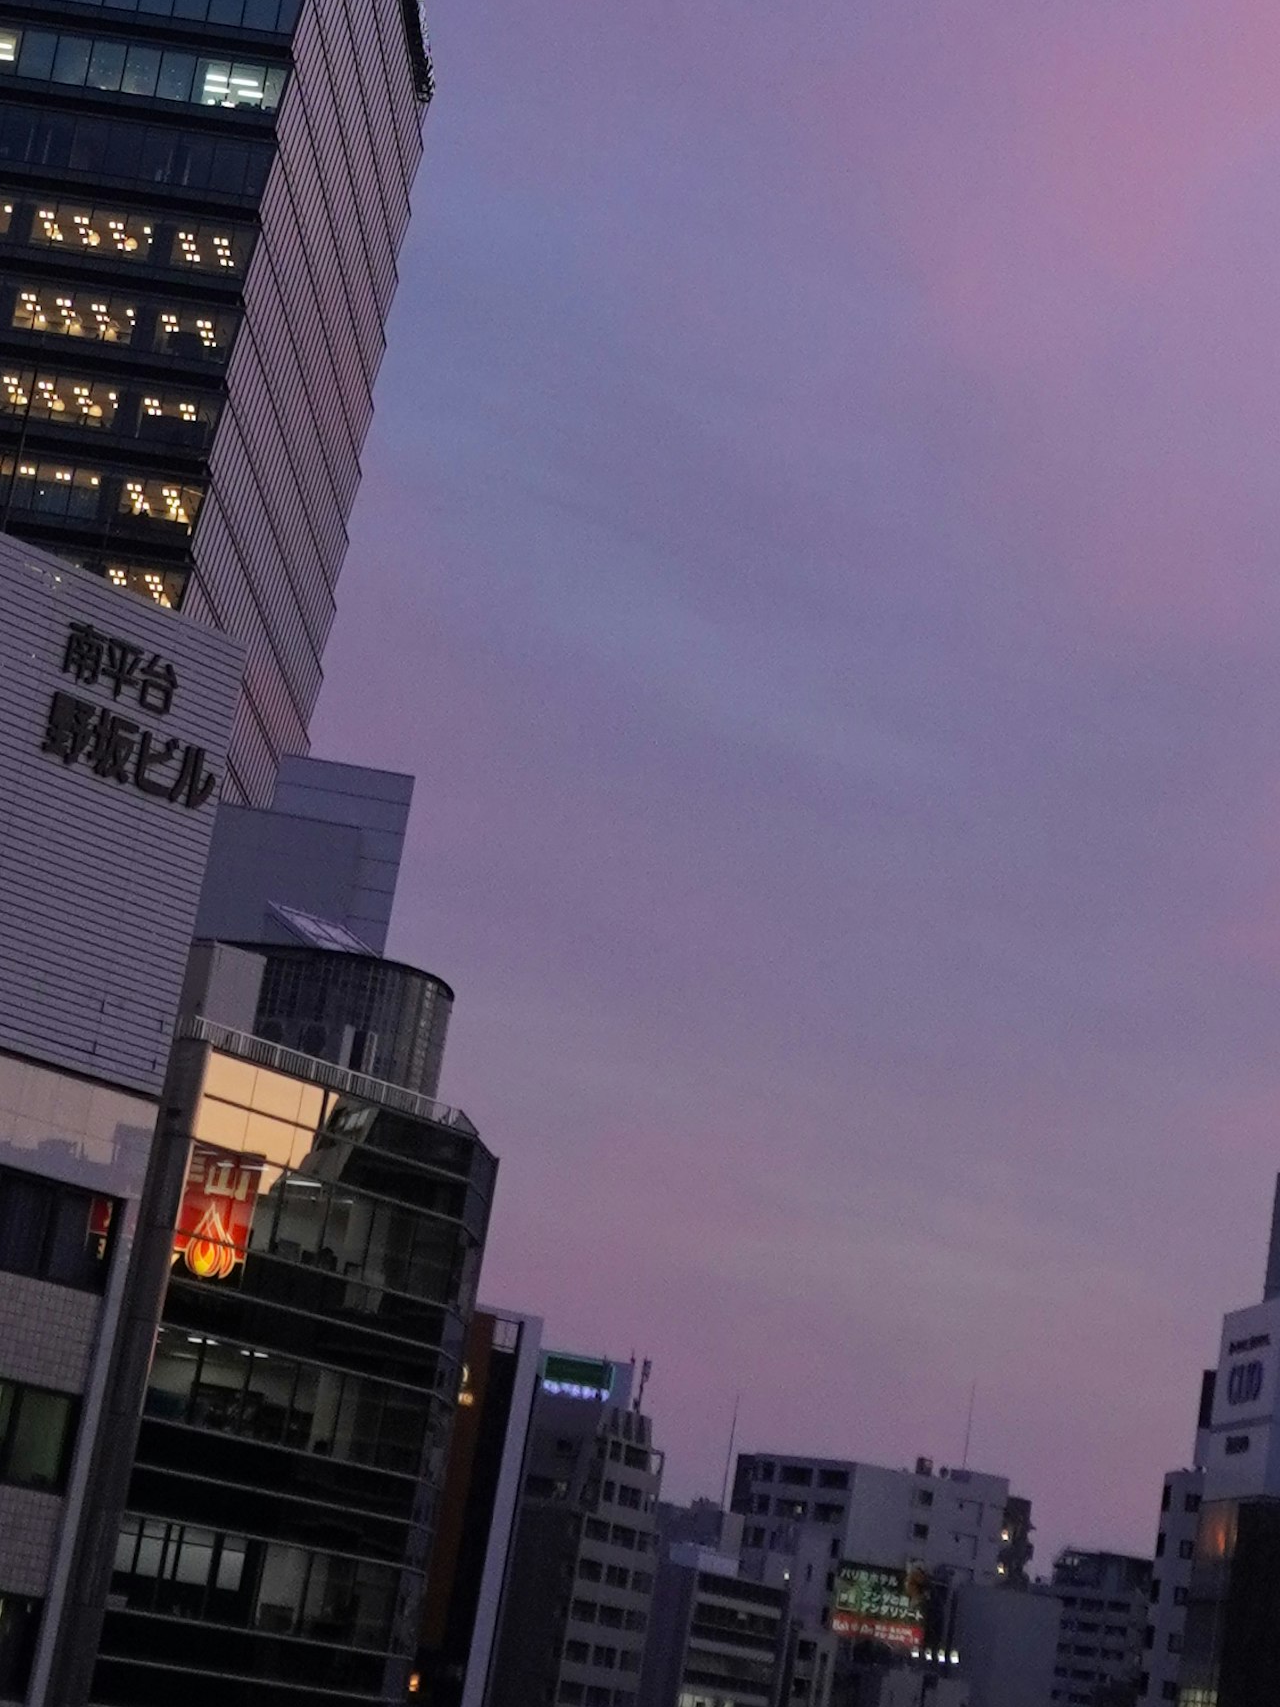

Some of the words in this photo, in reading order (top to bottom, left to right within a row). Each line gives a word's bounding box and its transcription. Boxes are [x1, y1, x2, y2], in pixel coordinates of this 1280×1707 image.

[63, 622, 178, 714] 南平台
[42, 691, 216, 808] 野坂ビル
